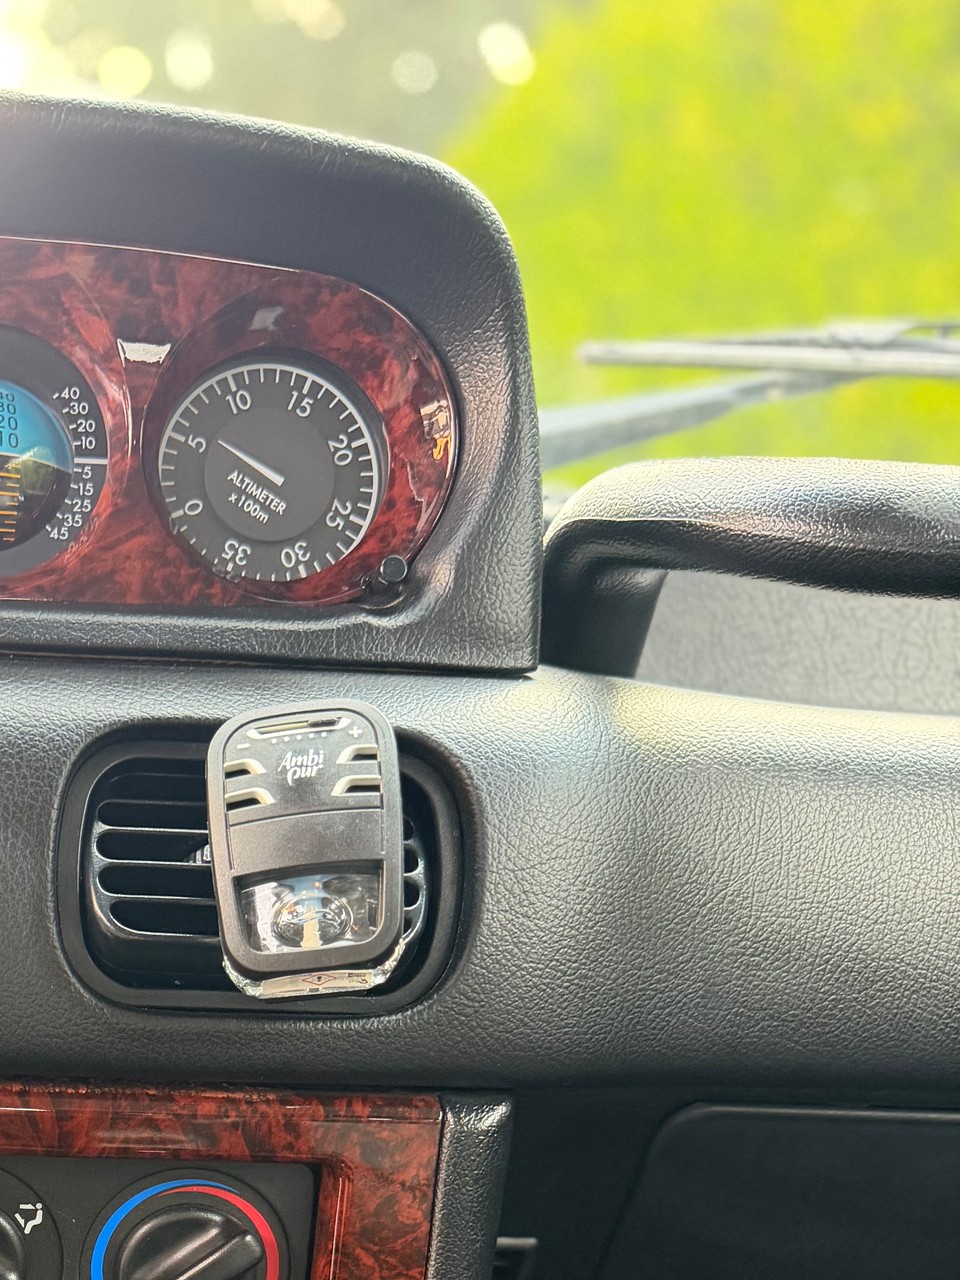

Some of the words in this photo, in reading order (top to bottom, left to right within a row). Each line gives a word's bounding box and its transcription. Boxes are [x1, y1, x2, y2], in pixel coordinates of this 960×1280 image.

[61, 387, 80, 400] 40
[69, 402, 89, 414] 30
[225, 390, 251, 415] 10
[287, 390, 314, 417] 15
[77, 420, 95, 433] 20
[81, 437, 95, 449] 10
[187, 432, 207, 453] 5
[327, 434, 352, 466] 20
[82, 466, 92, 478] 5
[78, 482, 93, 495] 15
[227, 469, 287, 515] ALTIMETER
[73, 499, 91, 512] 25
[183, 499, 203, 516] 0
[325, 498, 352, 530] 25
[64, 514, 82, 527] 35
[49, 527, 68, 540] 45
[221, 540, 252, 566] 35
[280, 541, 311, 568] 30
[277, 748, 325, 773] Ambi
